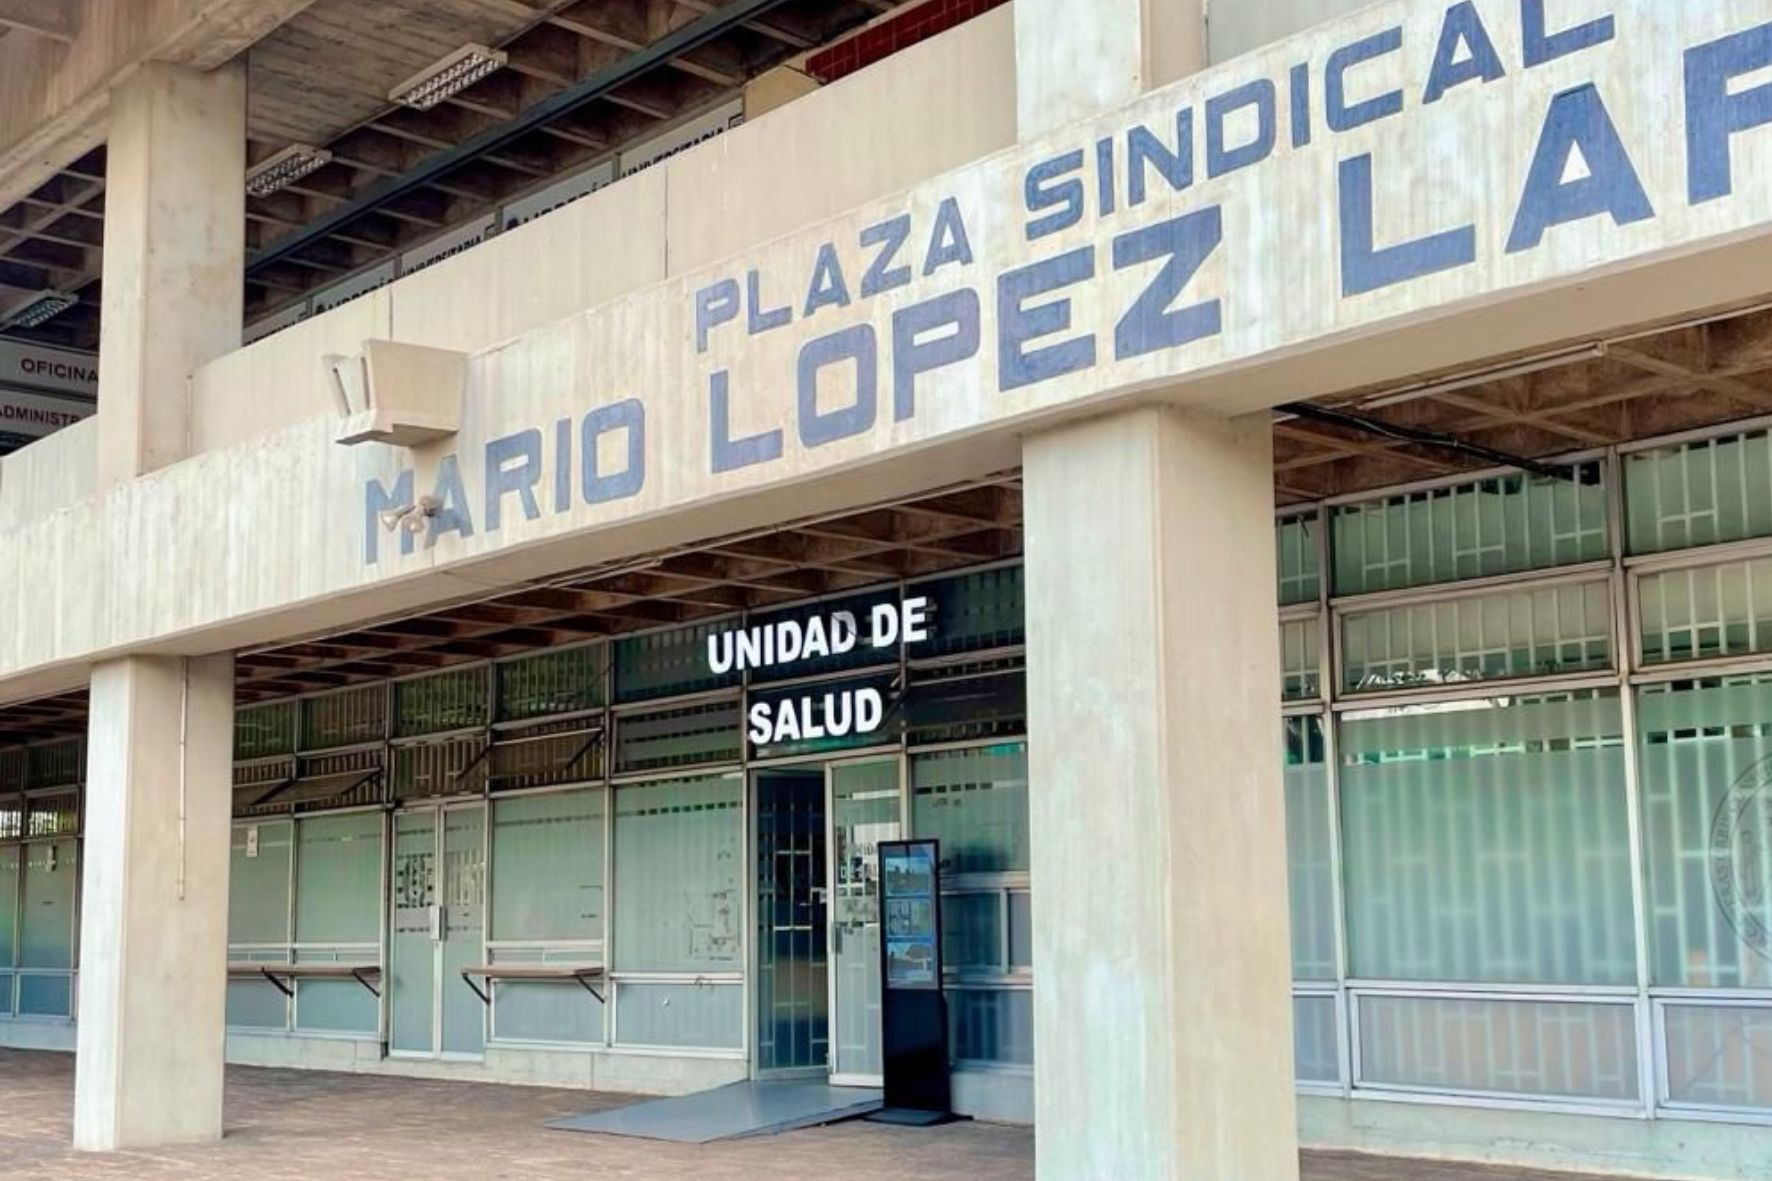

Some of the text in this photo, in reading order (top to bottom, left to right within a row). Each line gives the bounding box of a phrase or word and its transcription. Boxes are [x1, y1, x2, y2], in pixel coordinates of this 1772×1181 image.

[695, 0, 1615, 354] PLAZA SINDICAL
[21, 358, 98, 383] OFICINA
[365, 397, 646, 566] MARIO
[710, 204, 1222, 474] LOPEZ
[0, 405, 81, 427] DMINIST
[707, 596, 928, 674] UNIDAD DE
[749, 687, 883, 745] SALUD
